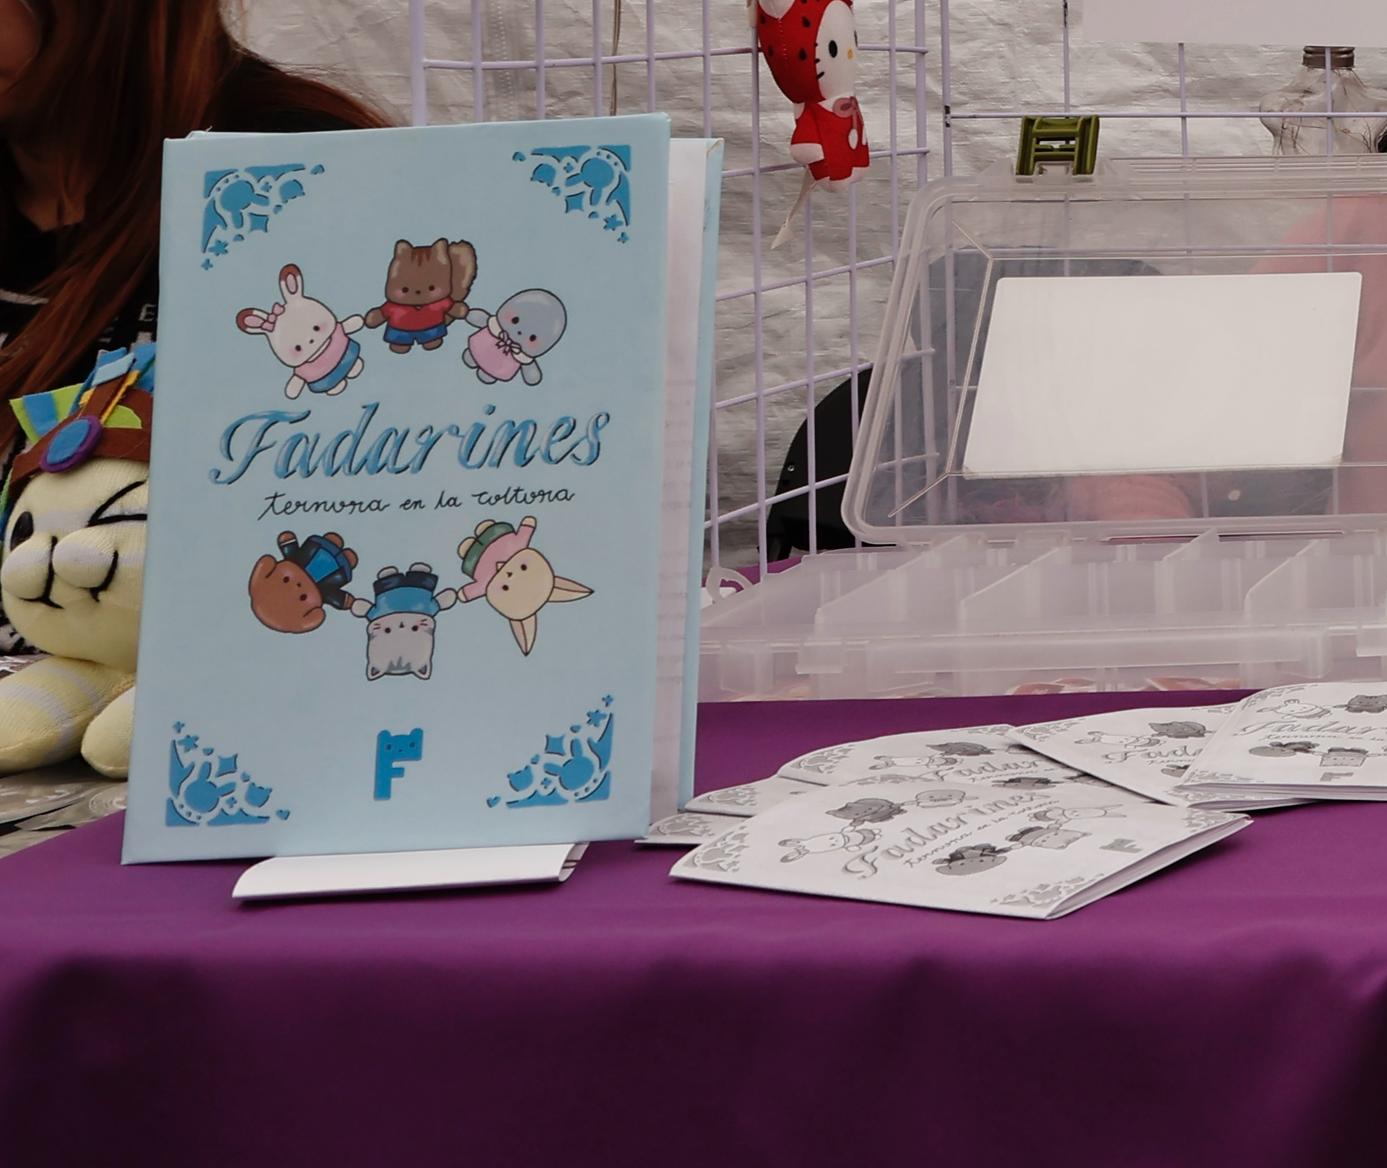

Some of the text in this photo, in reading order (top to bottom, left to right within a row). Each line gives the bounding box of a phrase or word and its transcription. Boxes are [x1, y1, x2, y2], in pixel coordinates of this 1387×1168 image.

[208, 402, 611, 485] Fadarines
[400, 496, 425, 511] en
[434, 491, 462, 509] la
